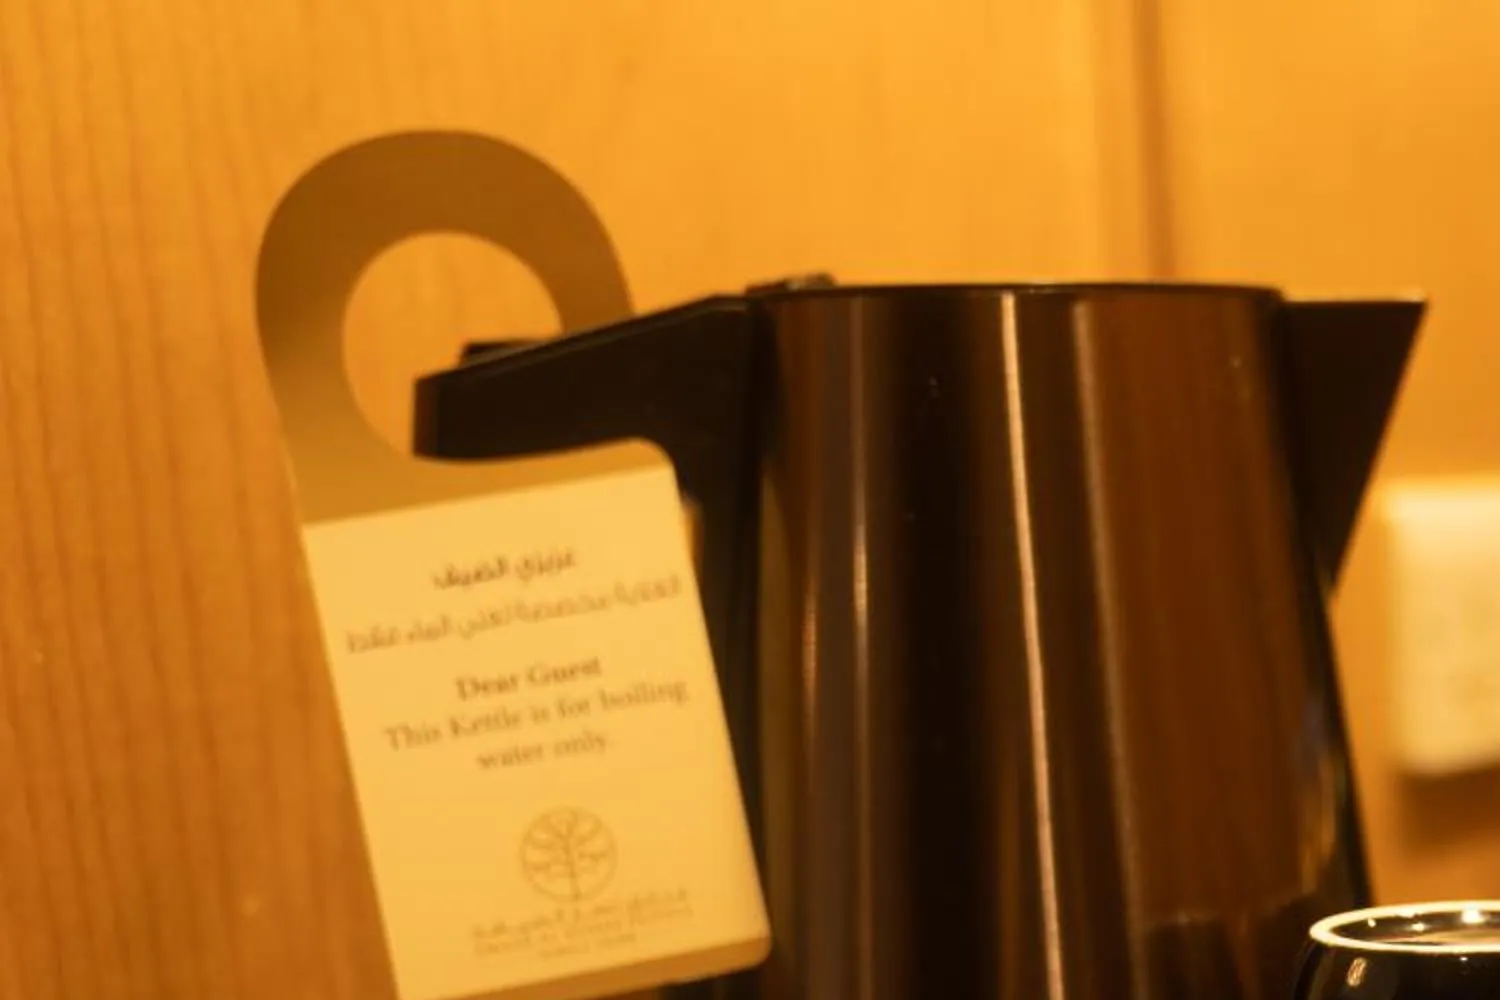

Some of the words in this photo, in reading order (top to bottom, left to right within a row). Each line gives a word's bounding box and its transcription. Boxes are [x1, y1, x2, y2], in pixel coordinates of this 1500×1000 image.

[455, 672, 518, 701] Dear
[525, 655, 601, 685] Guest
[385, 722, 443, 751] This
[449, 708, 521, 738] Kettle
[529, 706, 549, 723] is
[556, 697, 590, 718] for
[598, 680, 687, 711] boiling
[476, 743, 543, 769] water
